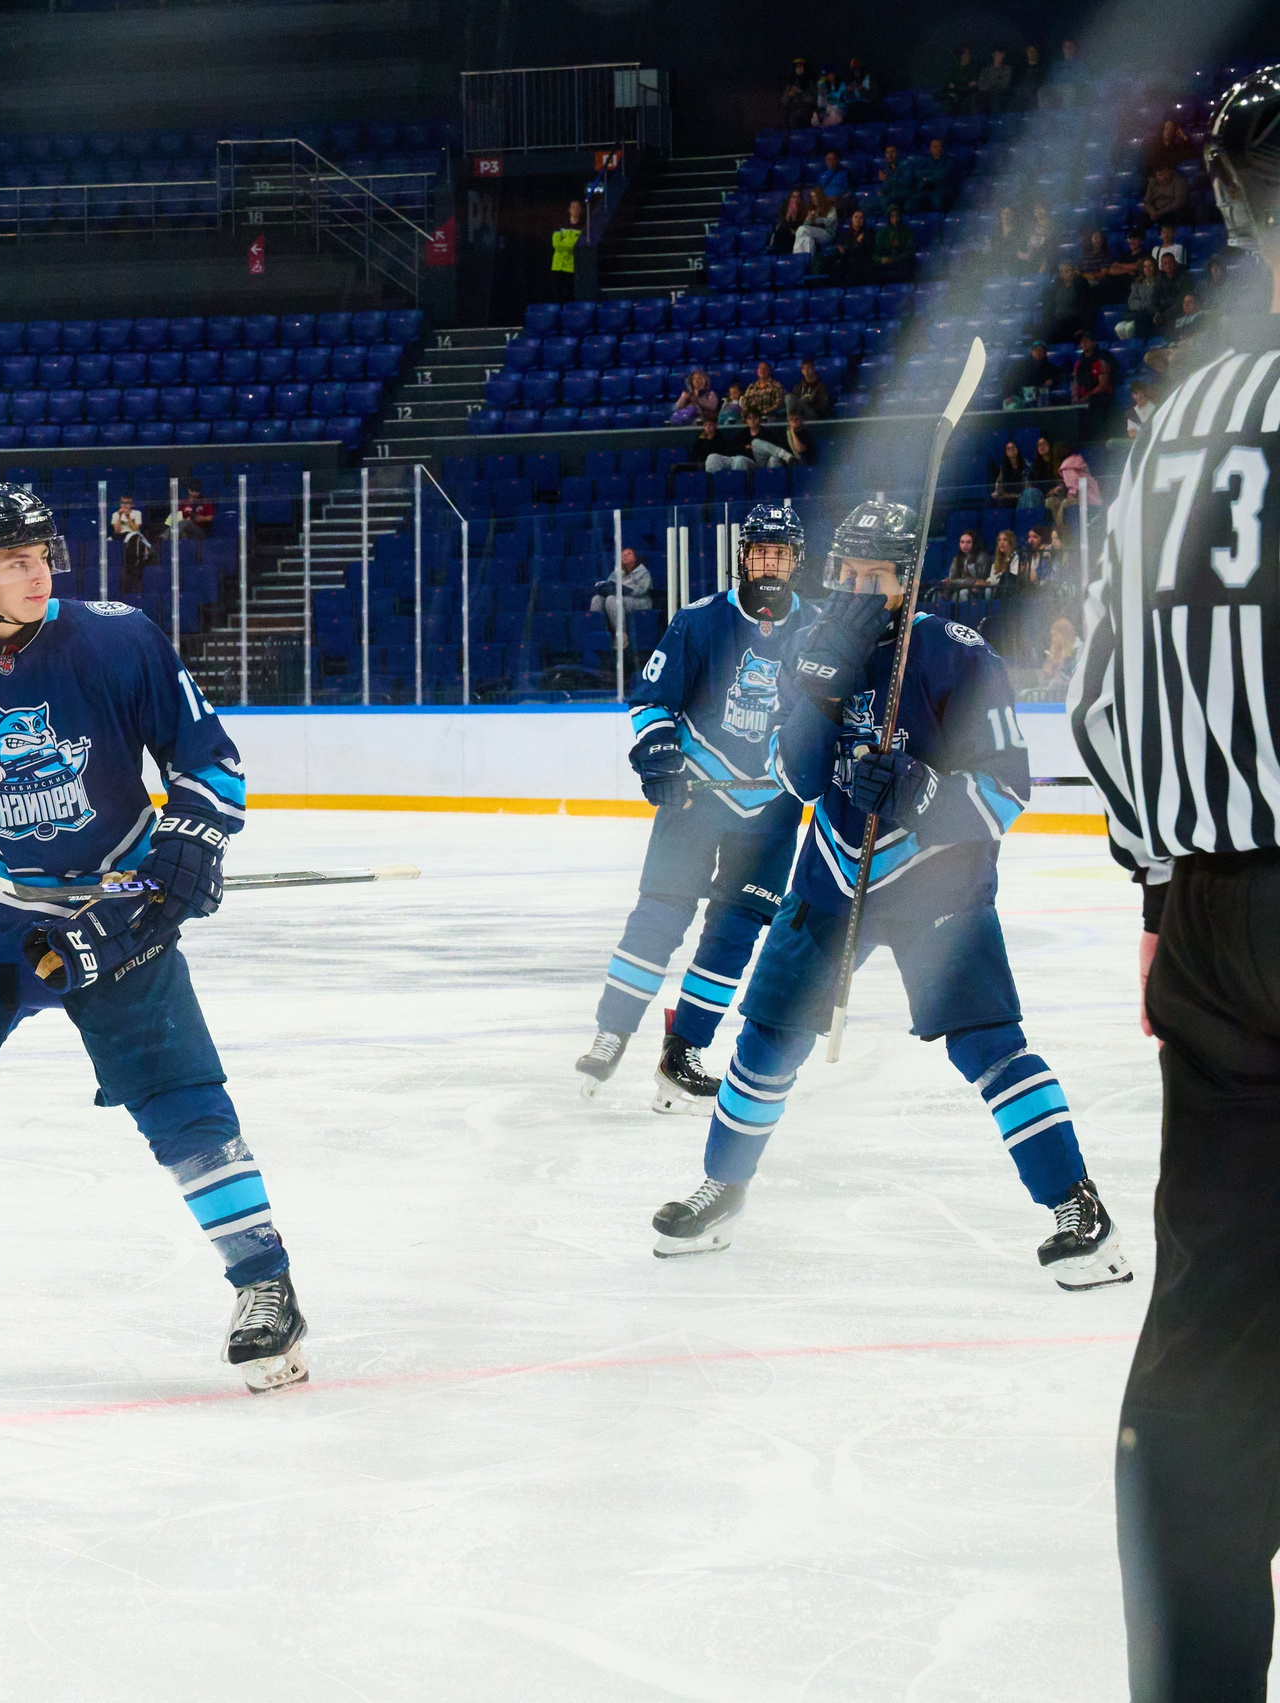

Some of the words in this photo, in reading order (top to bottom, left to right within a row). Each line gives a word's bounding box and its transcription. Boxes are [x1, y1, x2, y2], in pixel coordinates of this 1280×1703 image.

[480, 161, 500, 174] P3
[255, 181, 271, 193] 19
[247, 211, 264, 224] 18
[688, 257, 704, 271] 16
[437, 335, 452, 349] 14
[416, 371, 433, 385] 13
[396, 406, 413, 420] 12
[376, 444, 390, 458] 11
[858, 515, 878, 528] 10
[1153, 445, 1271, 592] 73
[4, 774, 67, 791] СИБИРСКИЕ
